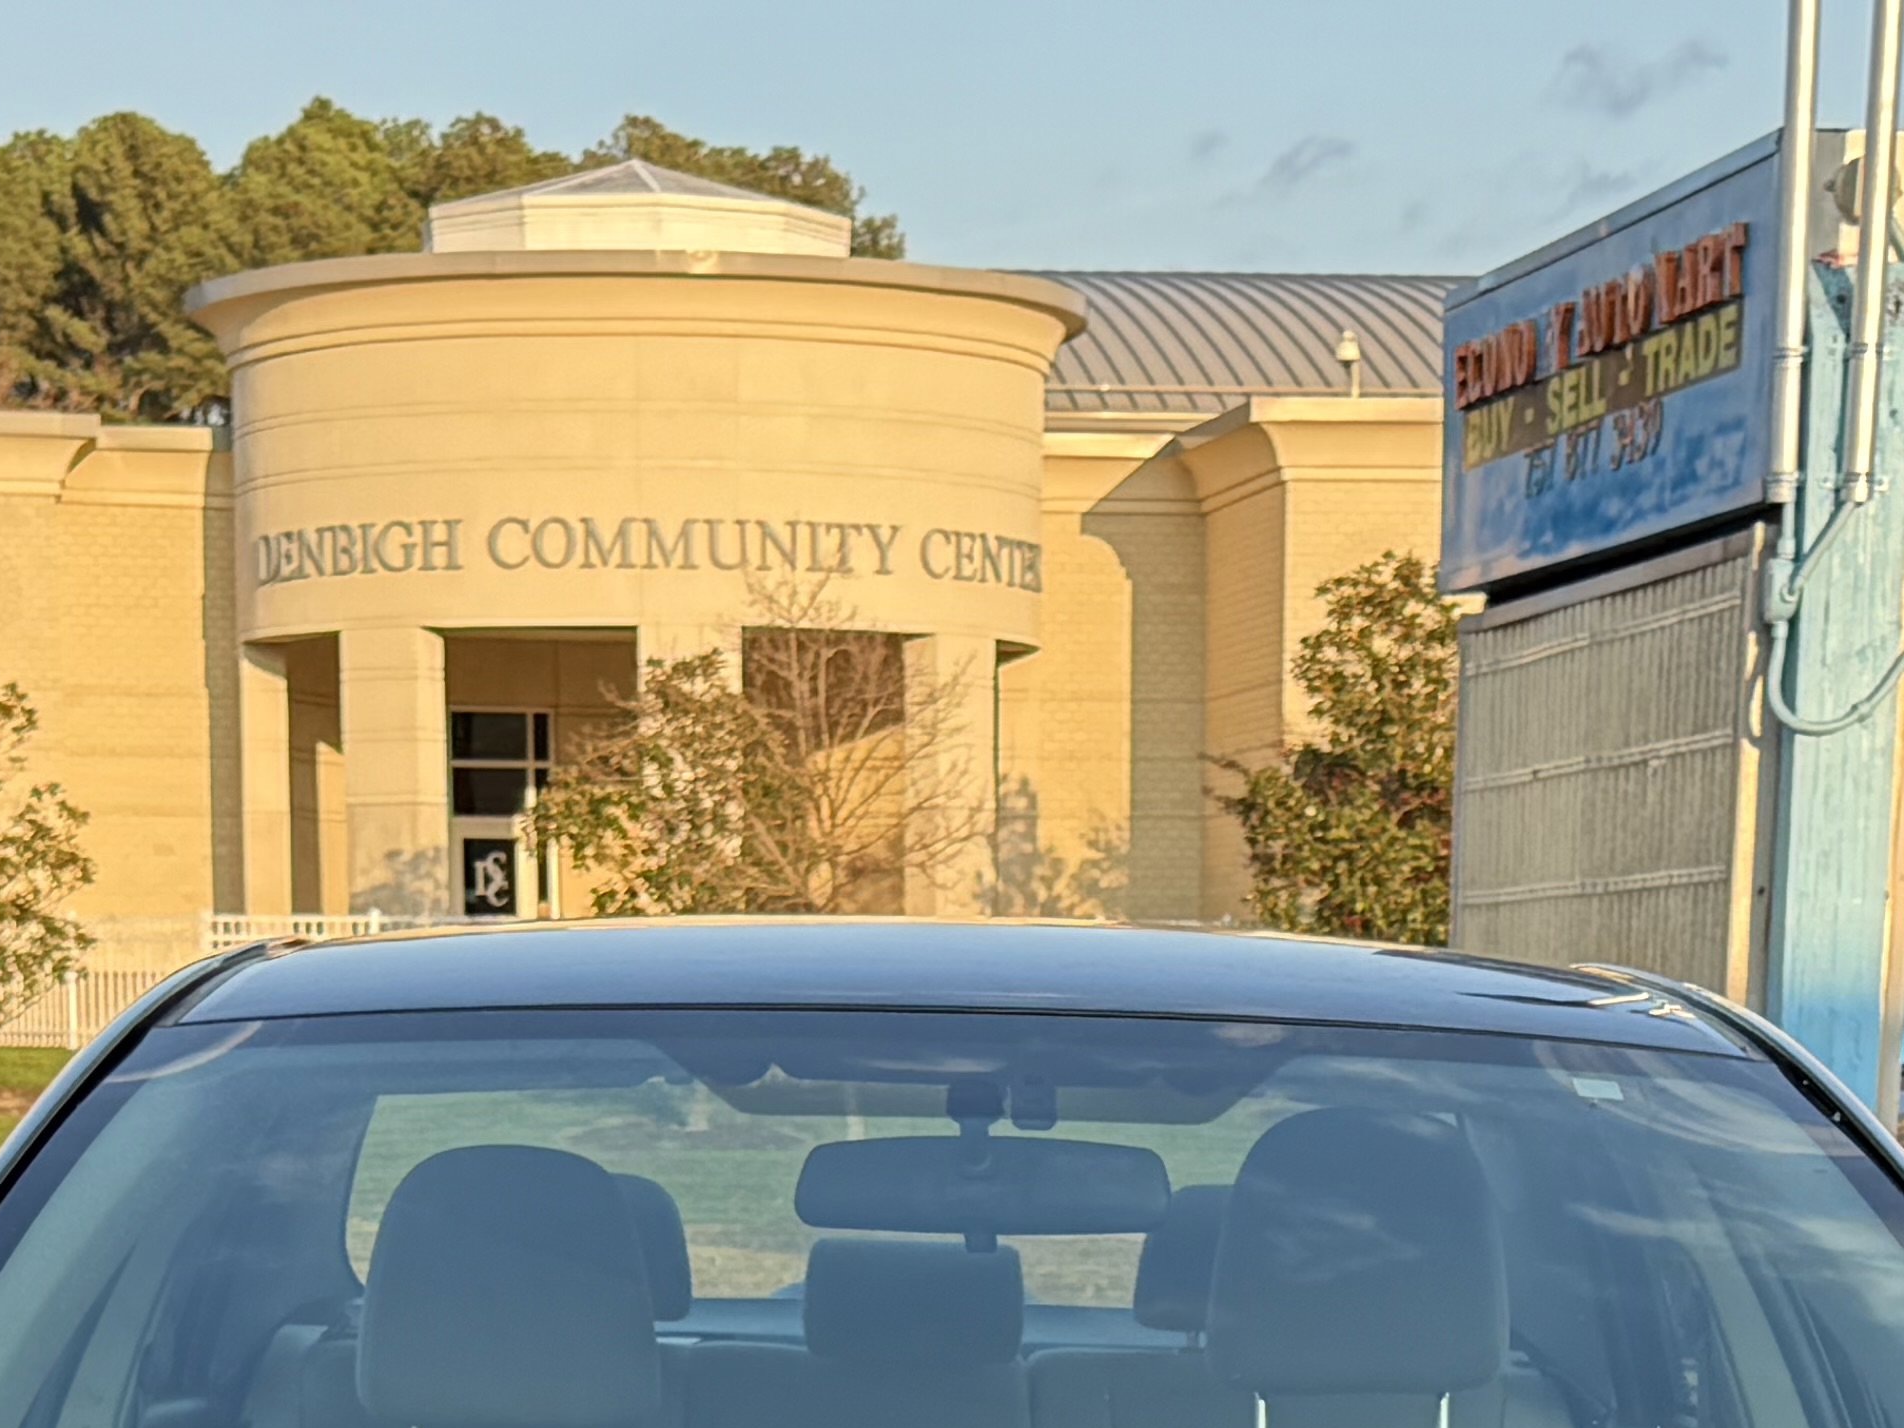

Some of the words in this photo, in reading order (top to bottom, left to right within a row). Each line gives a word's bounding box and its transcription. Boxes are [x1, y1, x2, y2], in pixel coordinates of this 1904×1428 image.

[1454, 301, 1577, 411] ECONOY
[1577, 264, 1653, 357] AUTO
[1464, 396, 1514, 464] BUY
[1546, 358, 1607, 435] SELL
[1641, 303, 1740, 398] TRADE
[257, 519, 464, 586] DENBIGH
[487, 516, 903, 576] COMMUNITY
[919, 528, 1043, 593] CENTE
